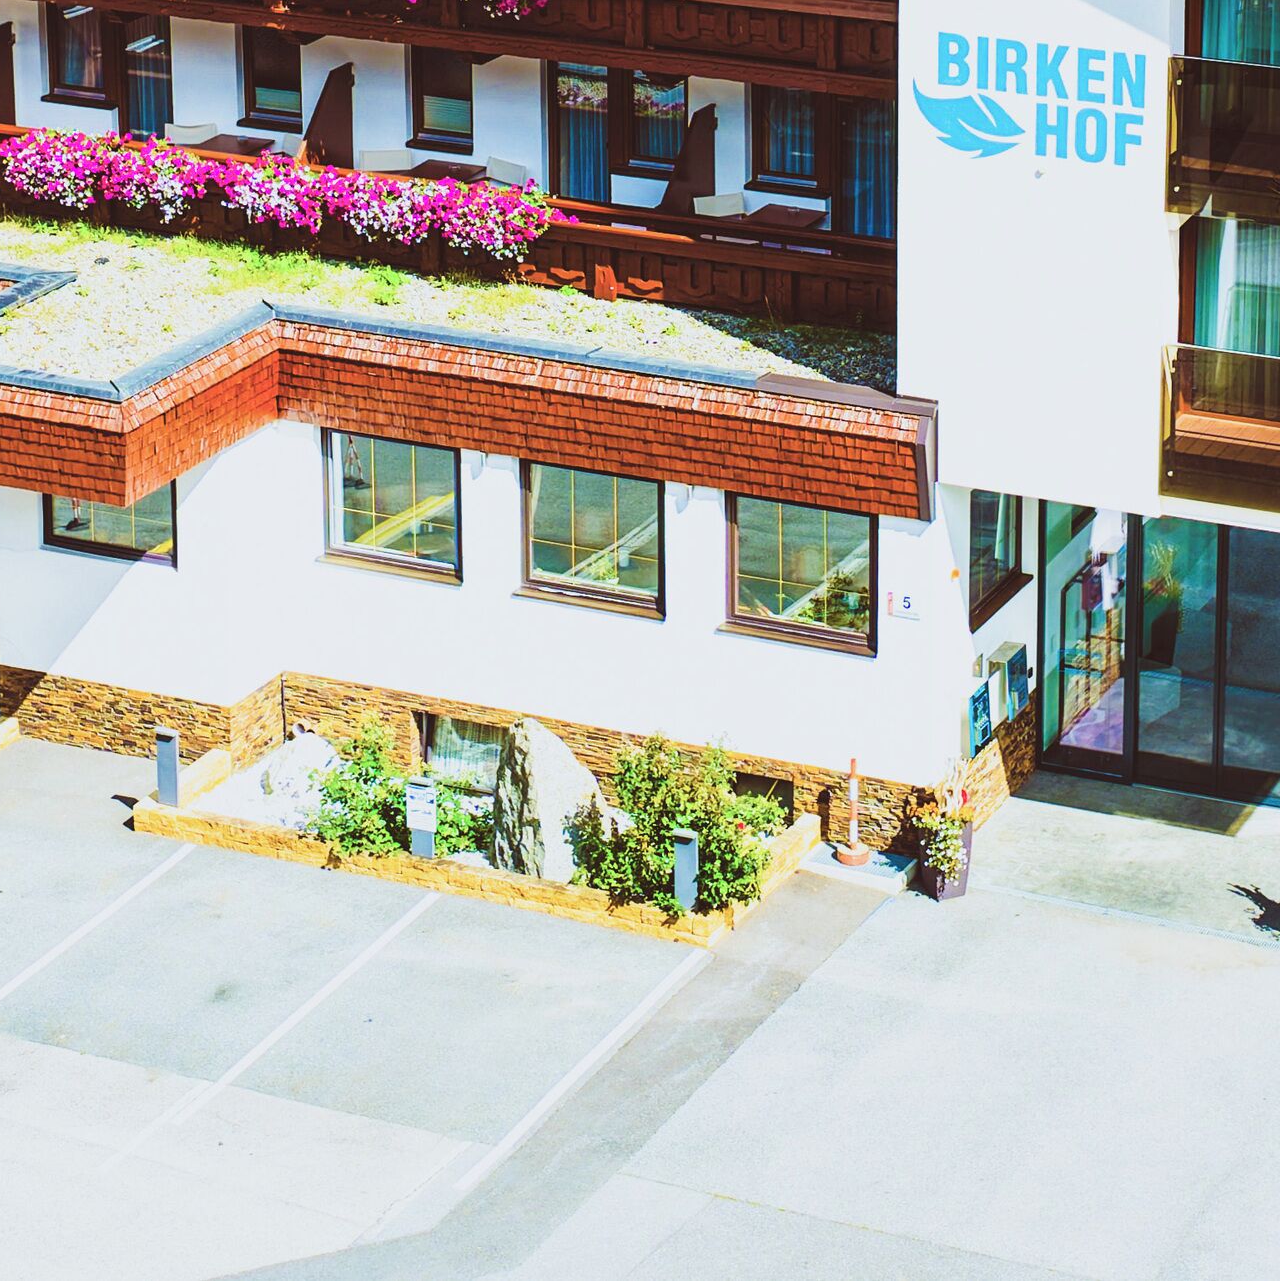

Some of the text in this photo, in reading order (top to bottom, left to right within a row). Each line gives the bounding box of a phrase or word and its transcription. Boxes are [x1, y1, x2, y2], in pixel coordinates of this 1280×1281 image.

[937, 31, 1146, 109] BIRKEN
[1034, 103, 1145, 166] HOF
[903, 596, 911, 610] 5
